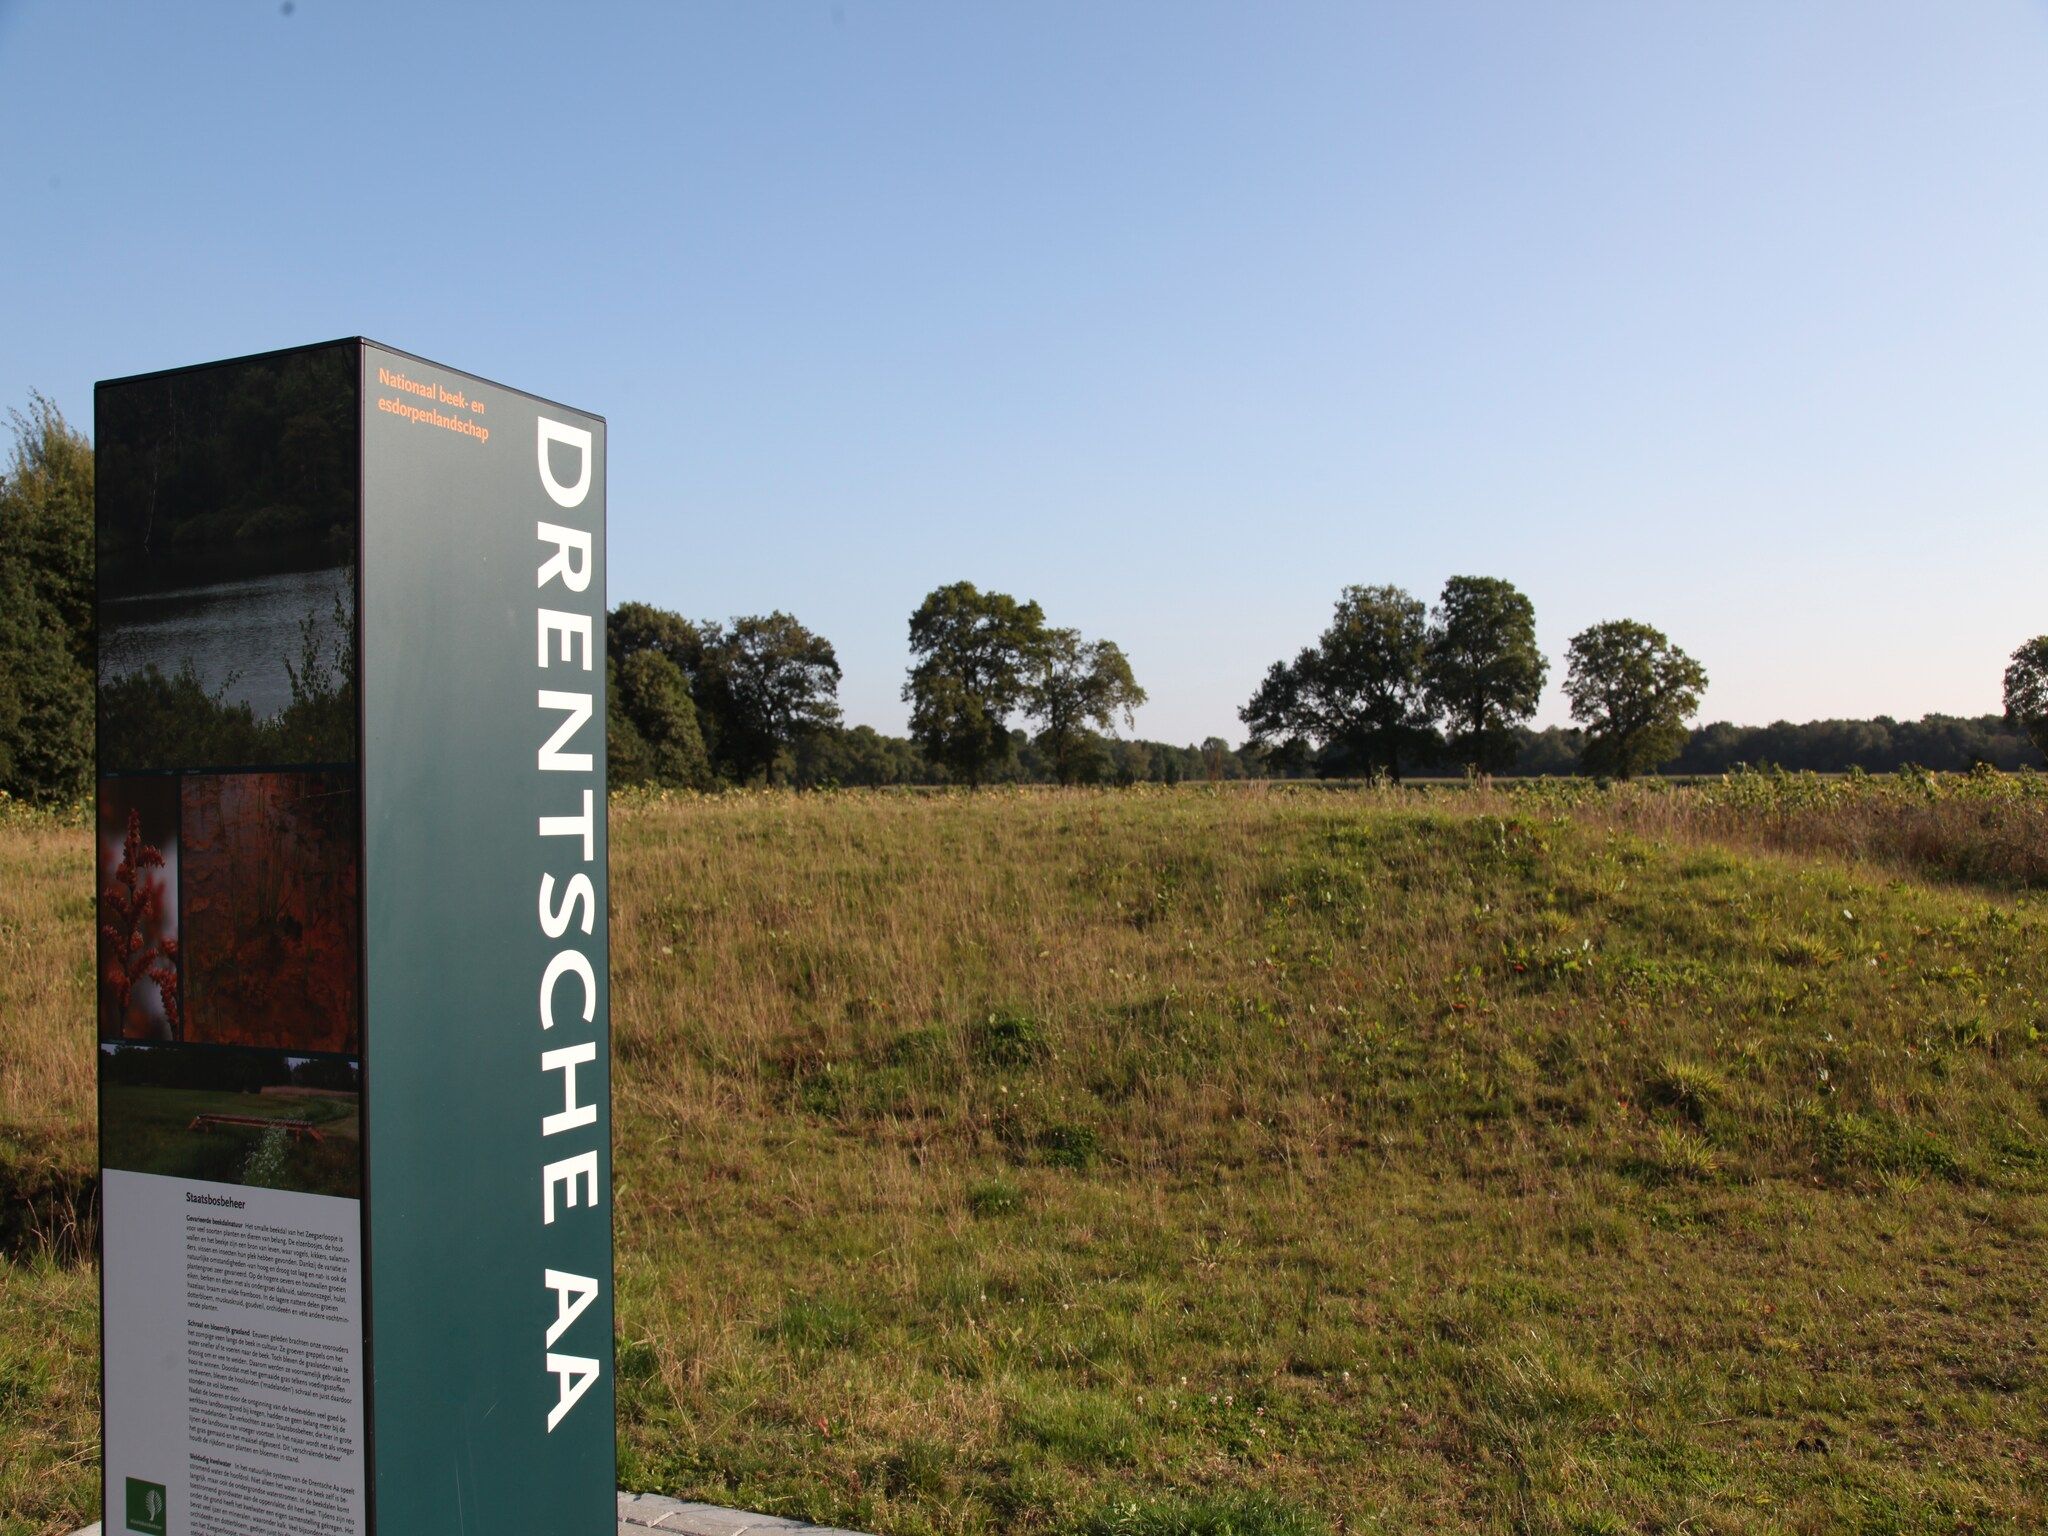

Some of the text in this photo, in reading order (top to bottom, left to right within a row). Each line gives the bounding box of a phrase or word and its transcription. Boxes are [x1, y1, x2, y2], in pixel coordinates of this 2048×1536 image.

[379, 367, 485, 414] Nationaal beek- en
[378, 396, 489, 443] esdorpenlandschap
[536, 415, 600, 1433] DRENTSCHE AA
[186, 1191, 246, 1209] Staatsbosbeheer
